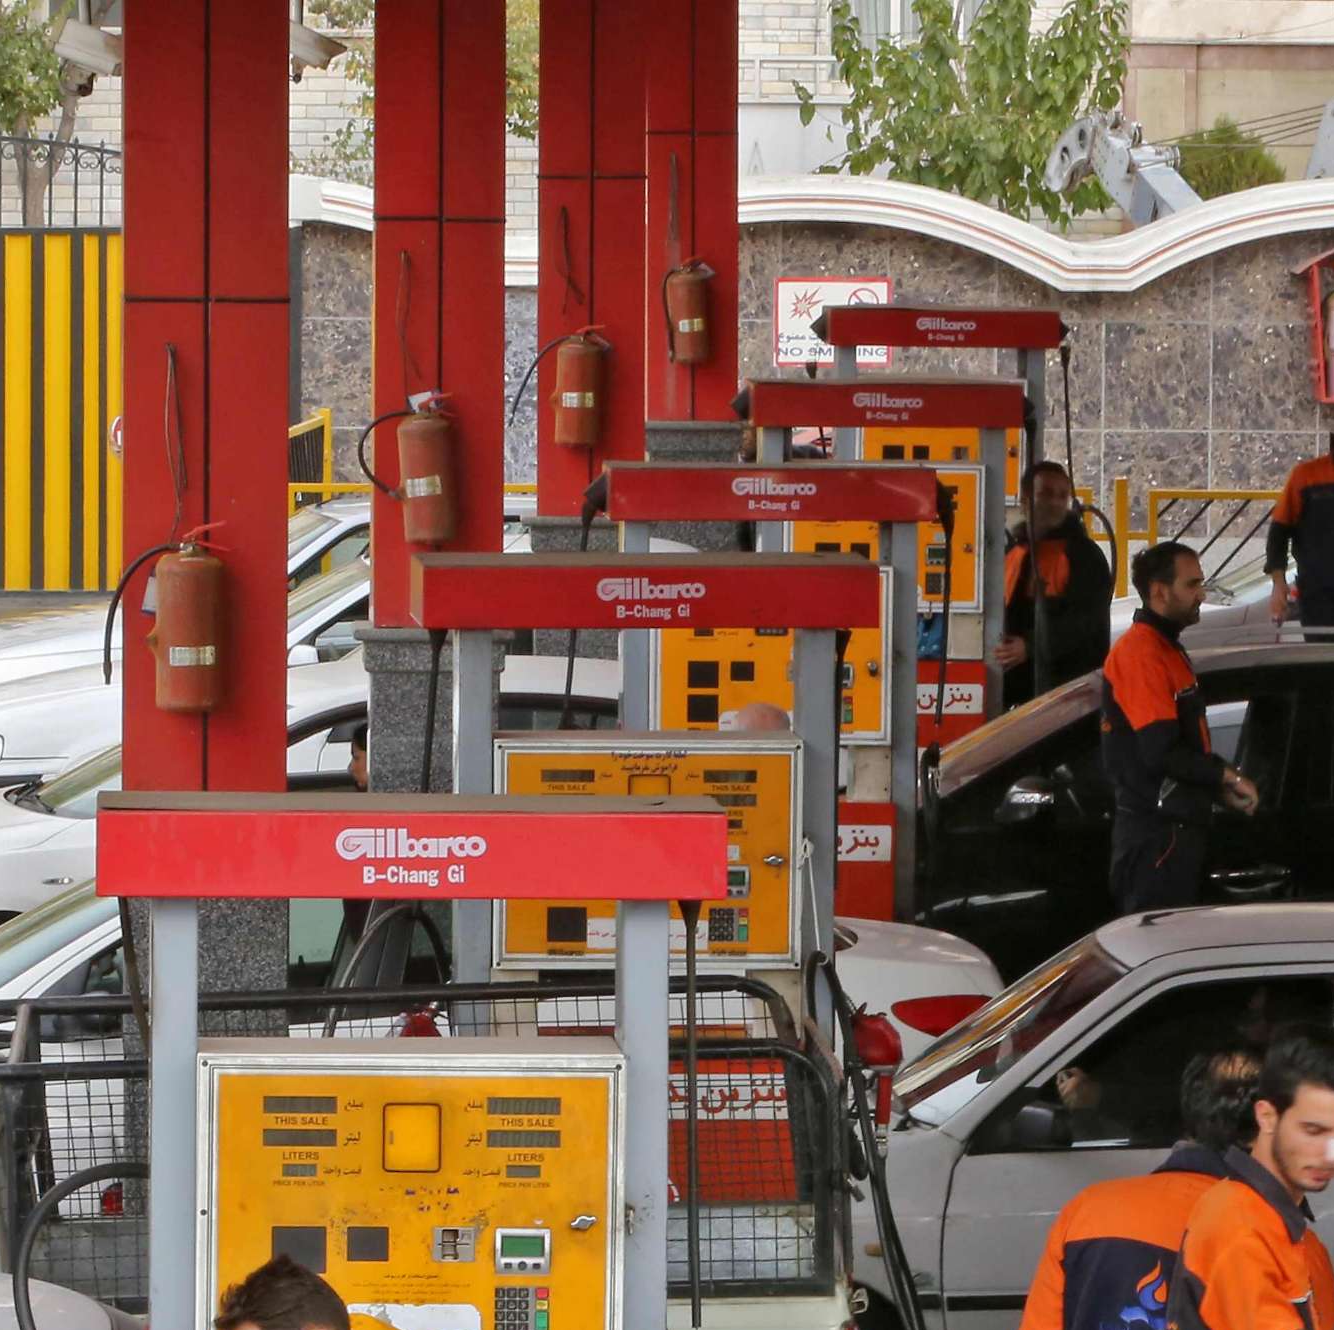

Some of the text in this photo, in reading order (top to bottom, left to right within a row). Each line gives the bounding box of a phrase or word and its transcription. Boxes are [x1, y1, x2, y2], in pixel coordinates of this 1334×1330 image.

[916, 317, 977, 331] Gilbarco
[779, 347, 888, 357] NO SMING
[853, 391, 923, 408] Gilbarco
[731, 477, 817, 496] Gilbarco
[596, 577, 706, 602] Gilbarco
[616, 604, 690, 620] B-Chang Gi
[335, 828, 487, 861] Gilbarco
[362, 865, 465, 887] B-Chang Gi
[274, 1116, 328, 1126] THIS SALE
[500, 1118, 555, 1127] THIS SALE
[282, 1151, 320, 1161] LITERS
[507, 1153, 545, 1163] LITERS
